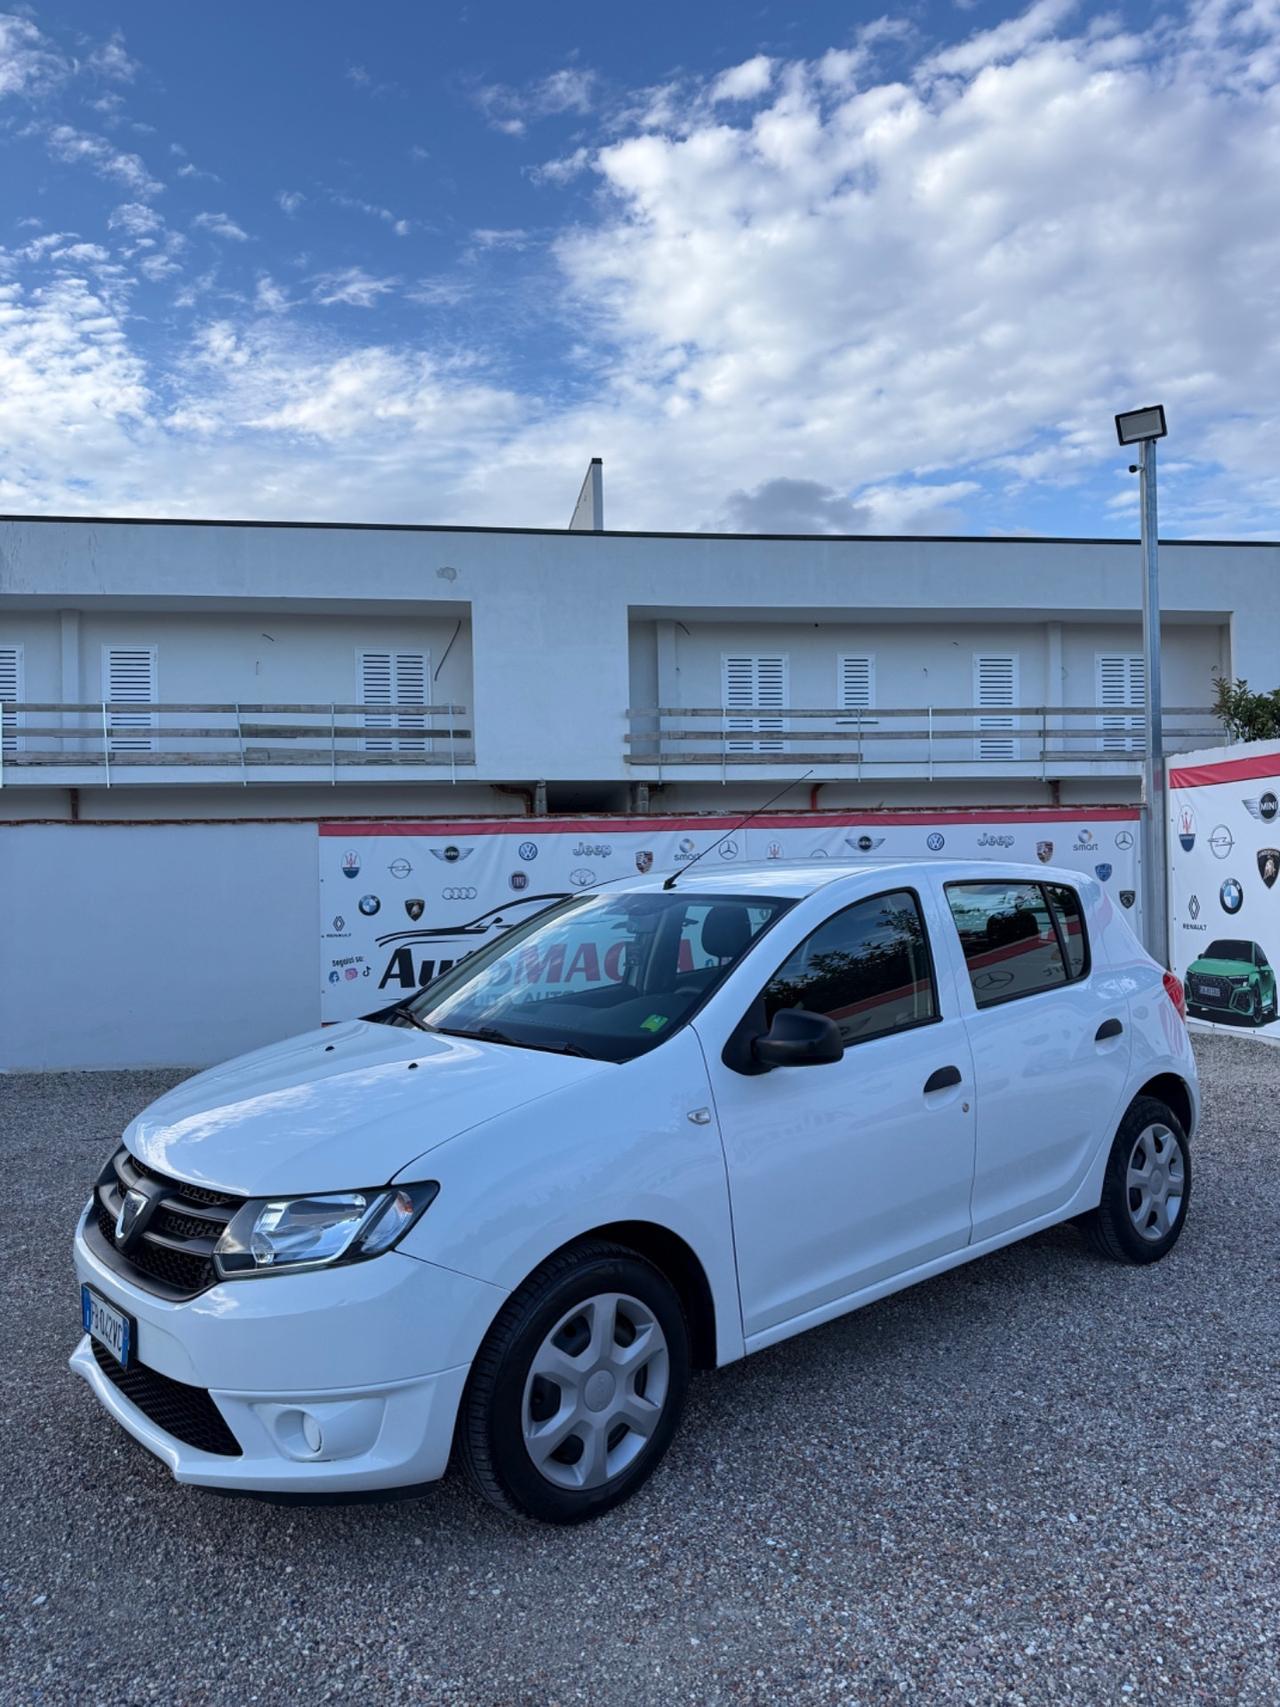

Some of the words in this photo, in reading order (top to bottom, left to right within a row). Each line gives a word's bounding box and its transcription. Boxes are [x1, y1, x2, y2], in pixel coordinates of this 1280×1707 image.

[977, 832, 1016, 848] Jeep
[1073, 841, 1099, 851] smart
[572, 841, 612, 858] Jeep
